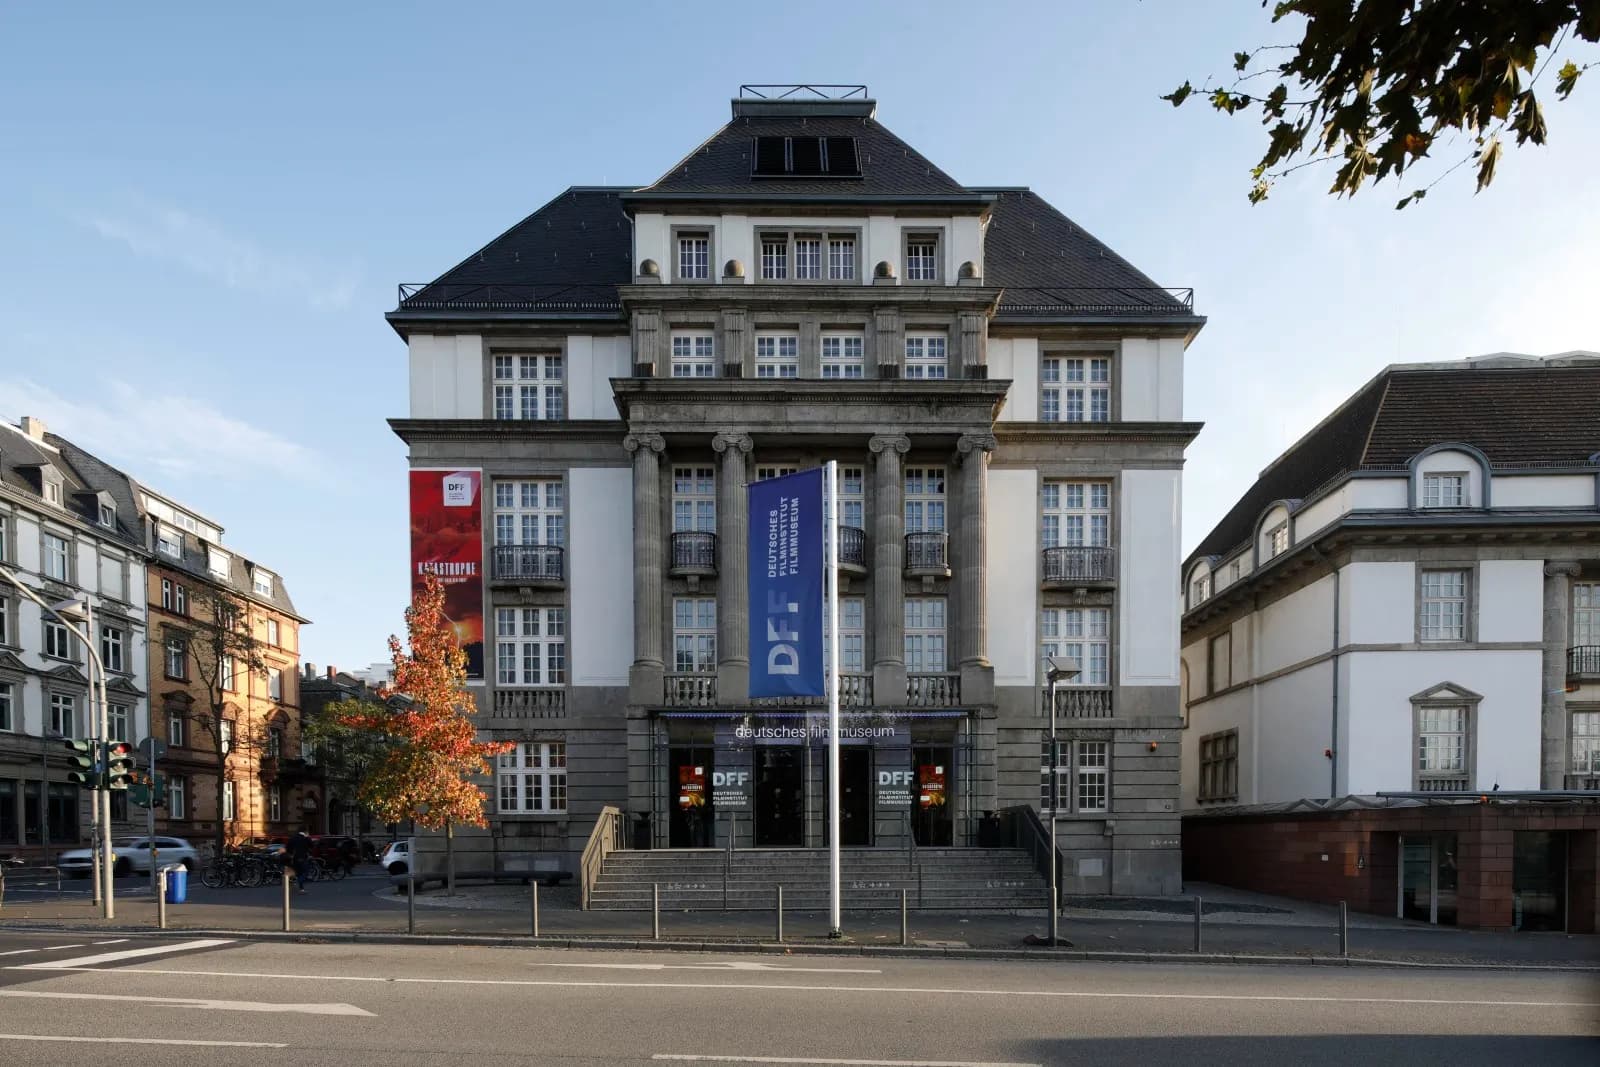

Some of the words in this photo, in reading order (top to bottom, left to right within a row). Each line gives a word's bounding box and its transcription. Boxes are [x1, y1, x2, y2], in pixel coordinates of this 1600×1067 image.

[448, 483, 465, 491] DFF
[768, 509, 778, 578] DEUTSCHES
[779, 496, 788, 577] FILMINSTITUT
[789, 497, 799, 575] FILMMUSEUM
[735, 725, 806, 738] deutsches
[712, 772, 749, 787] DFF
[878, 771, 915, 785] DFF
